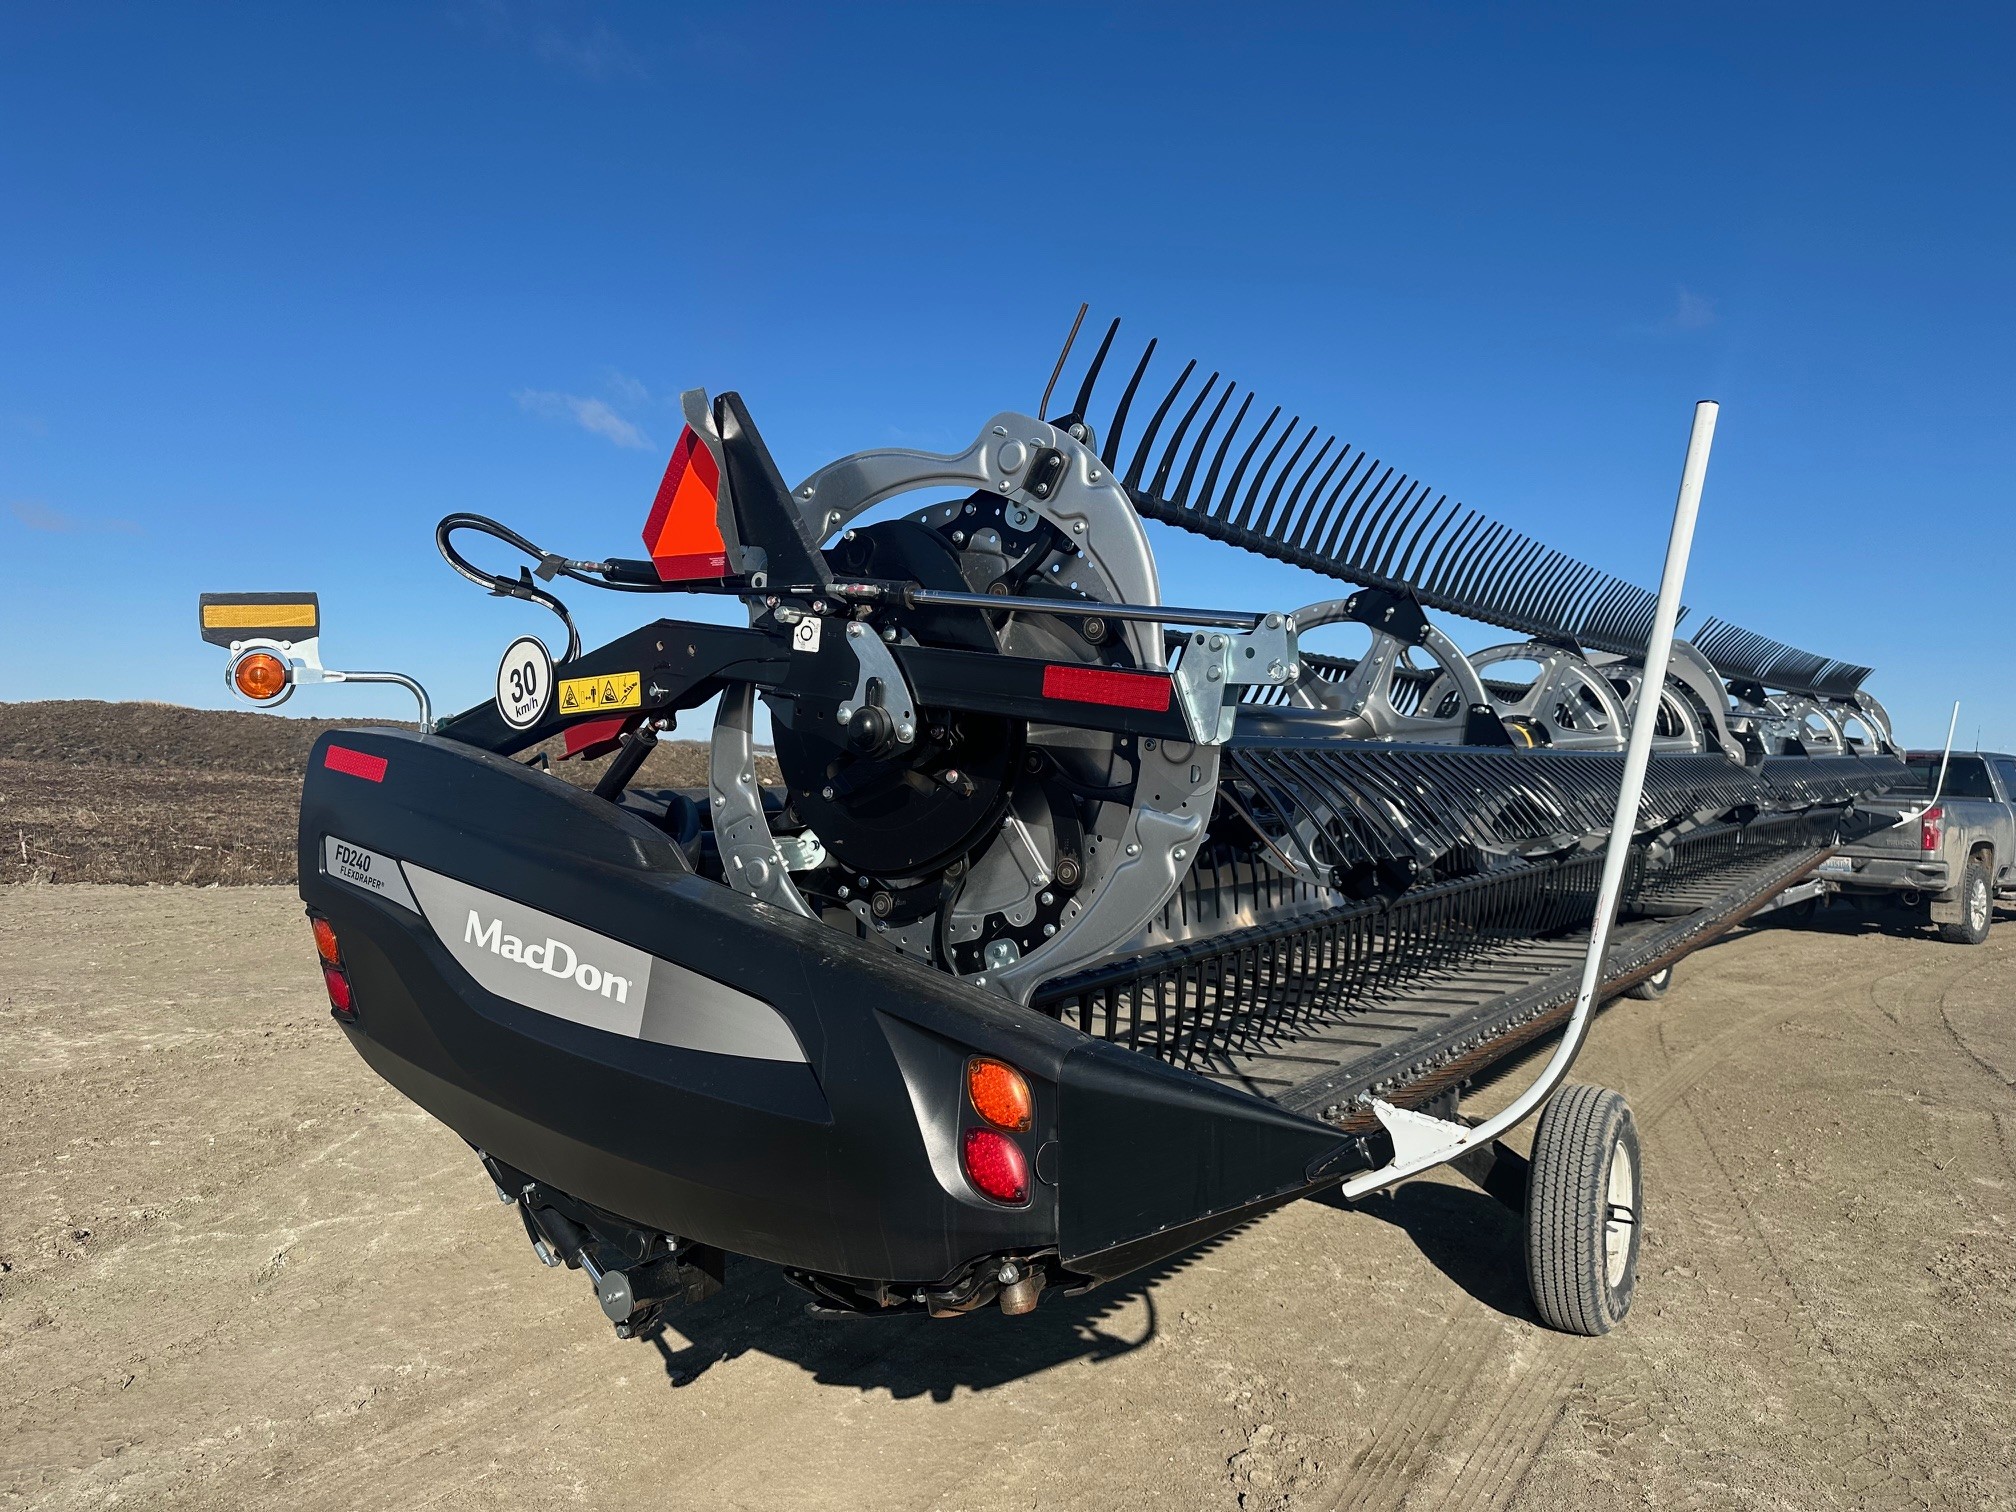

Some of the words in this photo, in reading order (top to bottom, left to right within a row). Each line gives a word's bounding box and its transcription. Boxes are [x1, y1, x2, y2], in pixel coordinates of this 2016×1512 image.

[509, 660, 537, 704] 30
[515, 696, 539, 718] km/h
[335, 844, 371, 872] FD240
[464, 909, 630, 1004] MacDon
